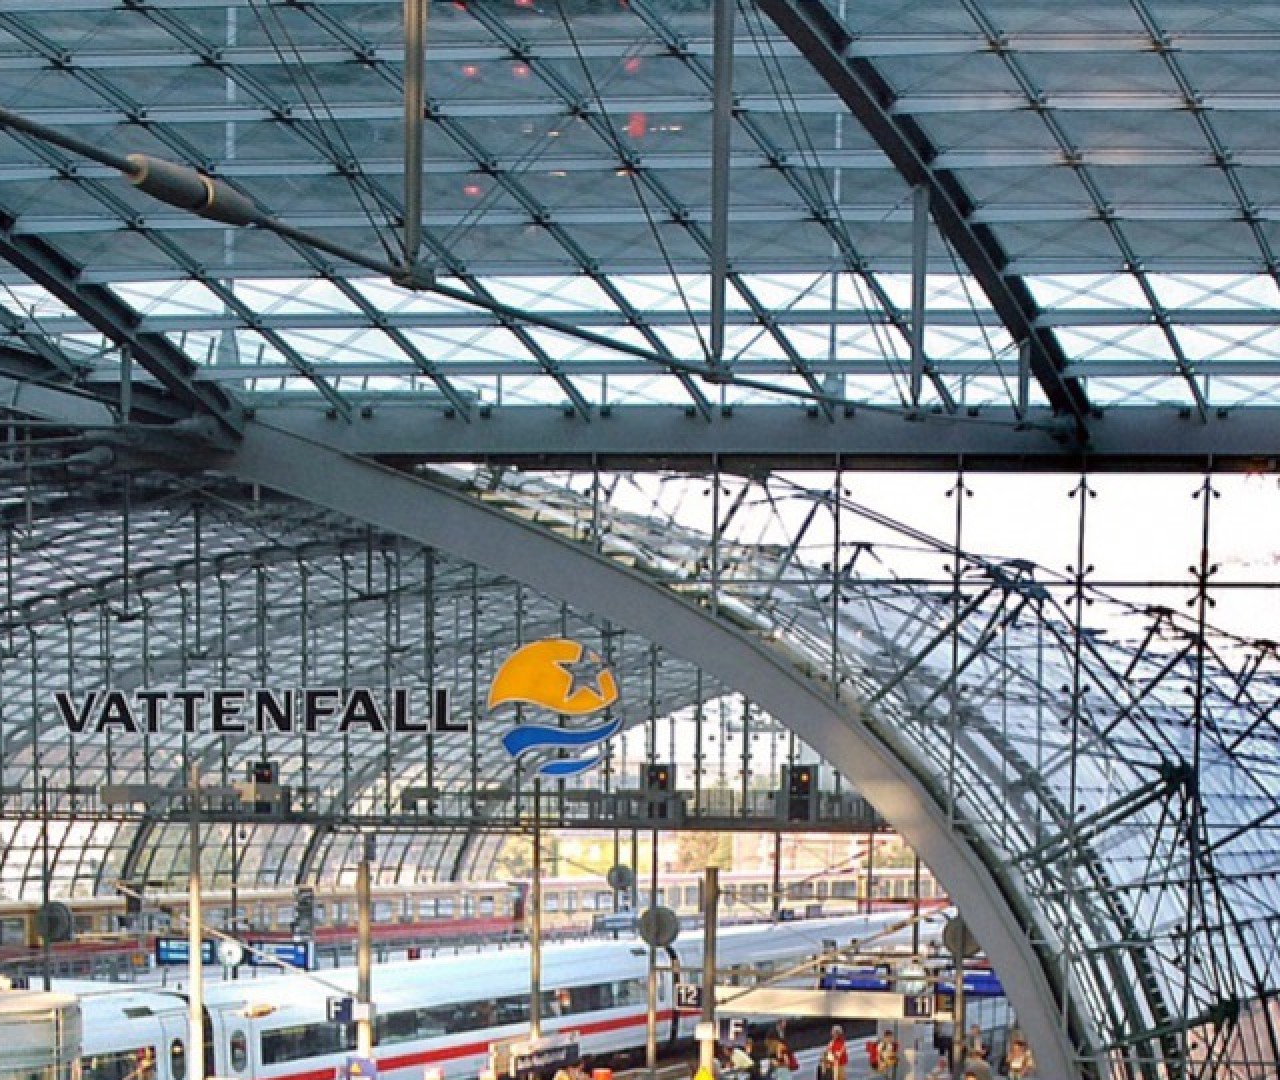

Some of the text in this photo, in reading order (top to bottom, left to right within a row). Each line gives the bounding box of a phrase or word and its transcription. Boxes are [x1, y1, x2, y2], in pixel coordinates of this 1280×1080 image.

[55, 688, 471, 734] VATTENFALL
[677, 984, 697, 1005] 12
[330, 999, 343, 1019] F
[729, 1019, 743, 1041] F
